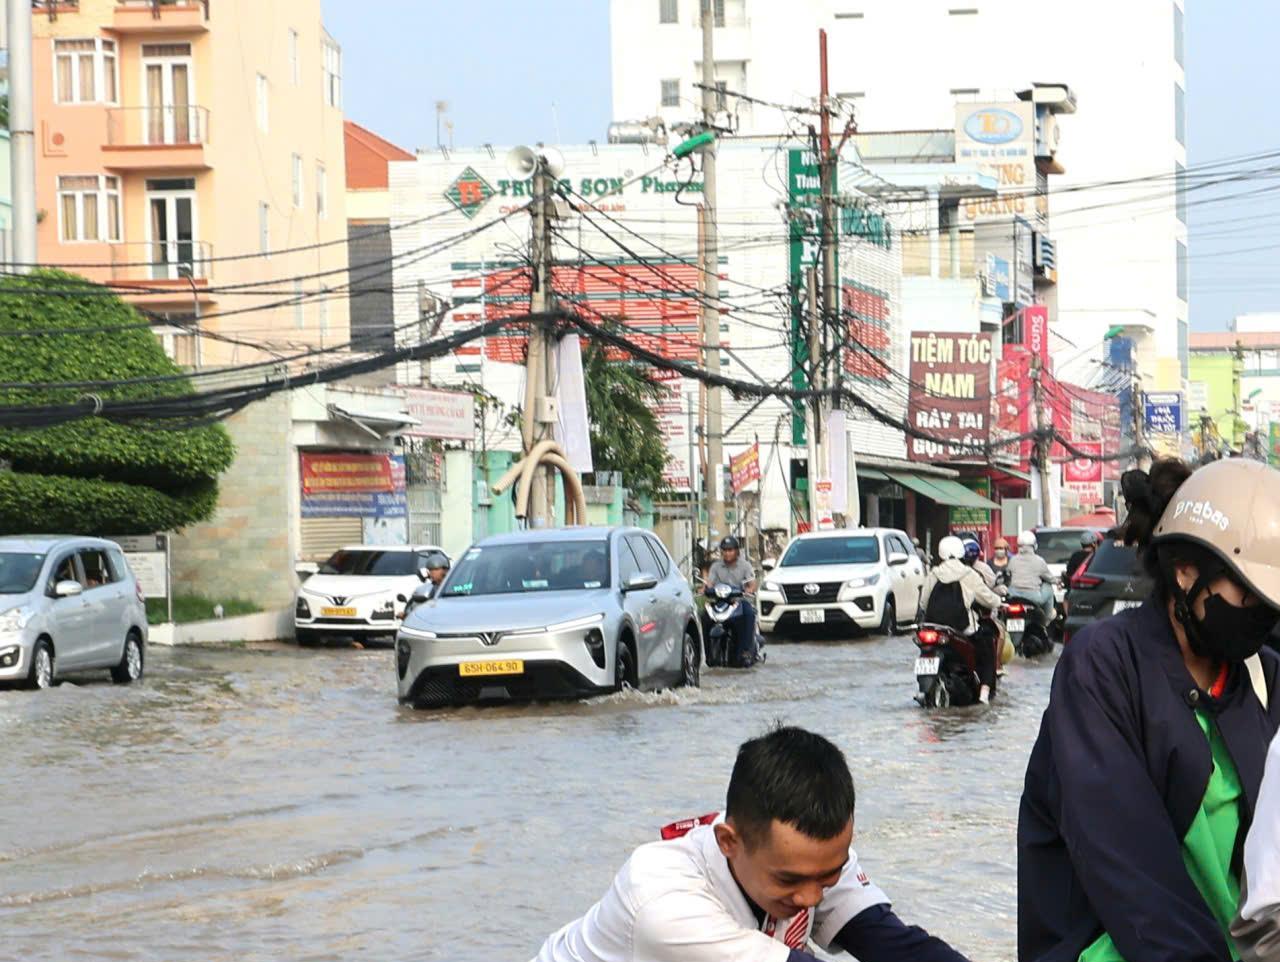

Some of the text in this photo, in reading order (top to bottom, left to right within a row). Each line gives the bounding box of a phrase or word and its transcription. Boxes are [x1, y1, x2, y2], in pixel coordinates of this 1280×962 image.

[912, 333, 991, 368] TIỆM TÓC
[925, 373, 975, 398] NAM
